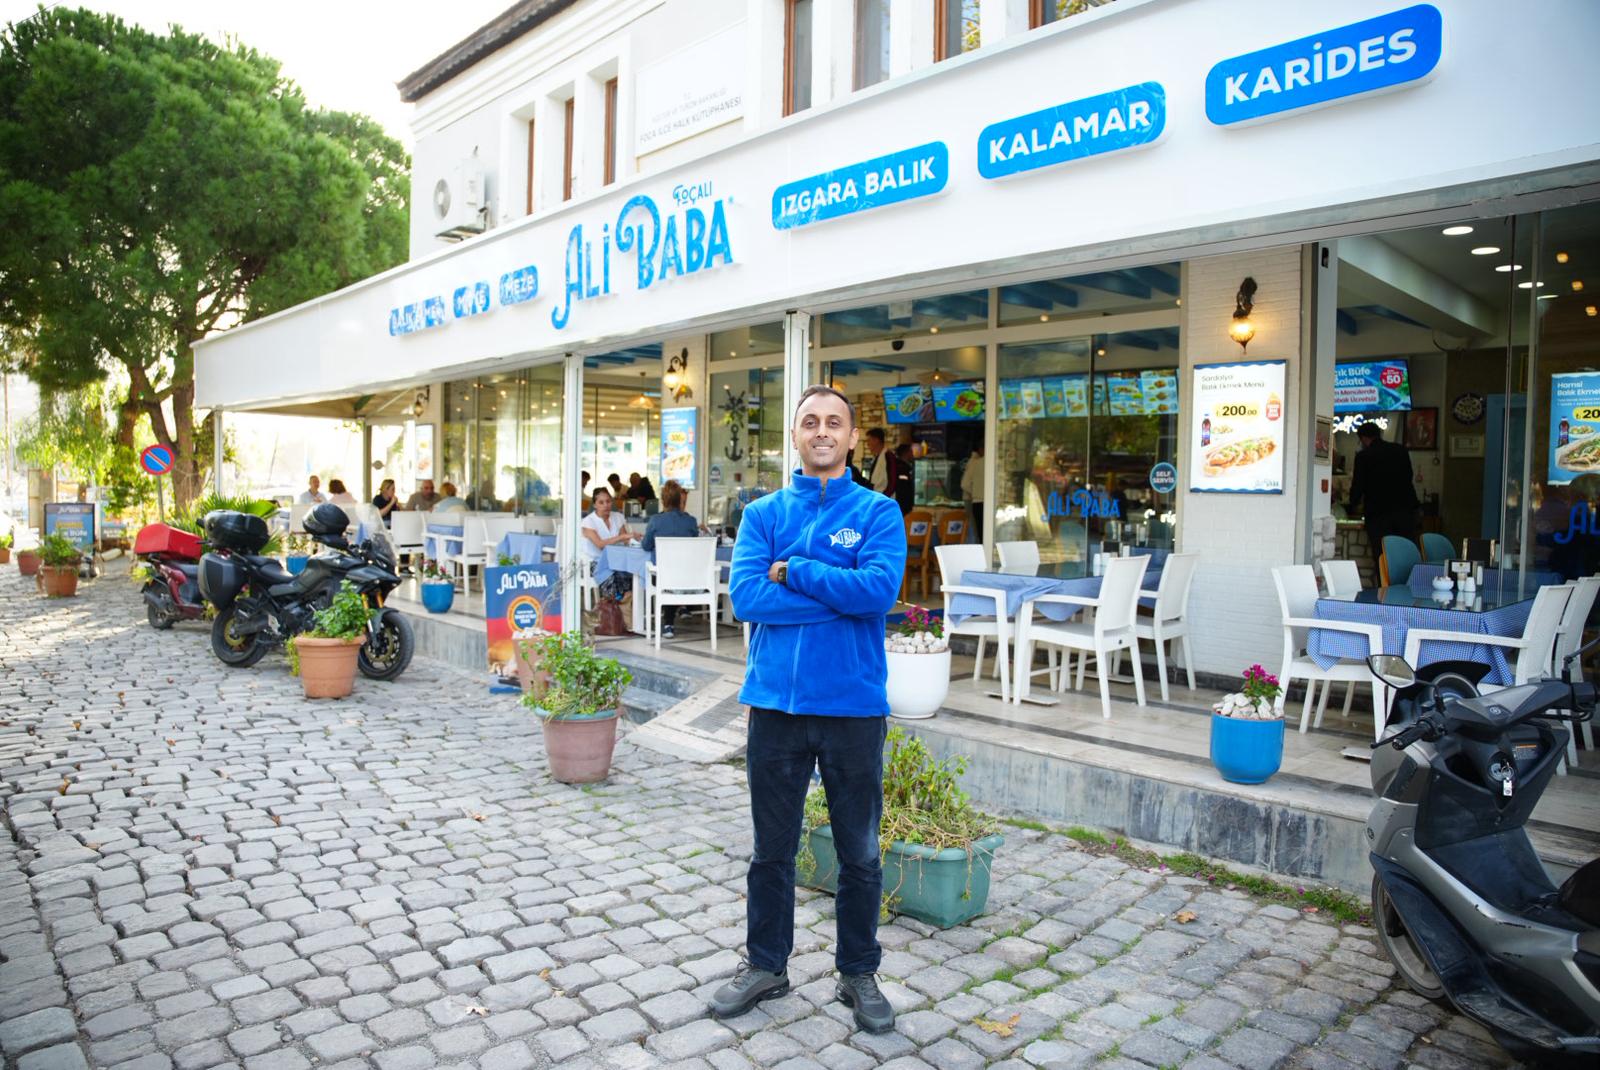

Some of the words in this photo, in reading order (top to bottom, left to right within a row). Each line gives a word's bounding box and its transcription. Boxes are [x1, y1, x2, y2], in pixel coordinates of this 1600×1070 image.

[1225, 28, 1417, 106] KARİDES
[989, 100, 1151, 164] KALAMAR
[780, 179, 859, 218] IZGARA
[865, 156, 936, 196] BALIK
[615, 194, 733, 289] BABA
[1073, 488, 1121, 518] BABA
[517, 570, 549, 589] BABA
